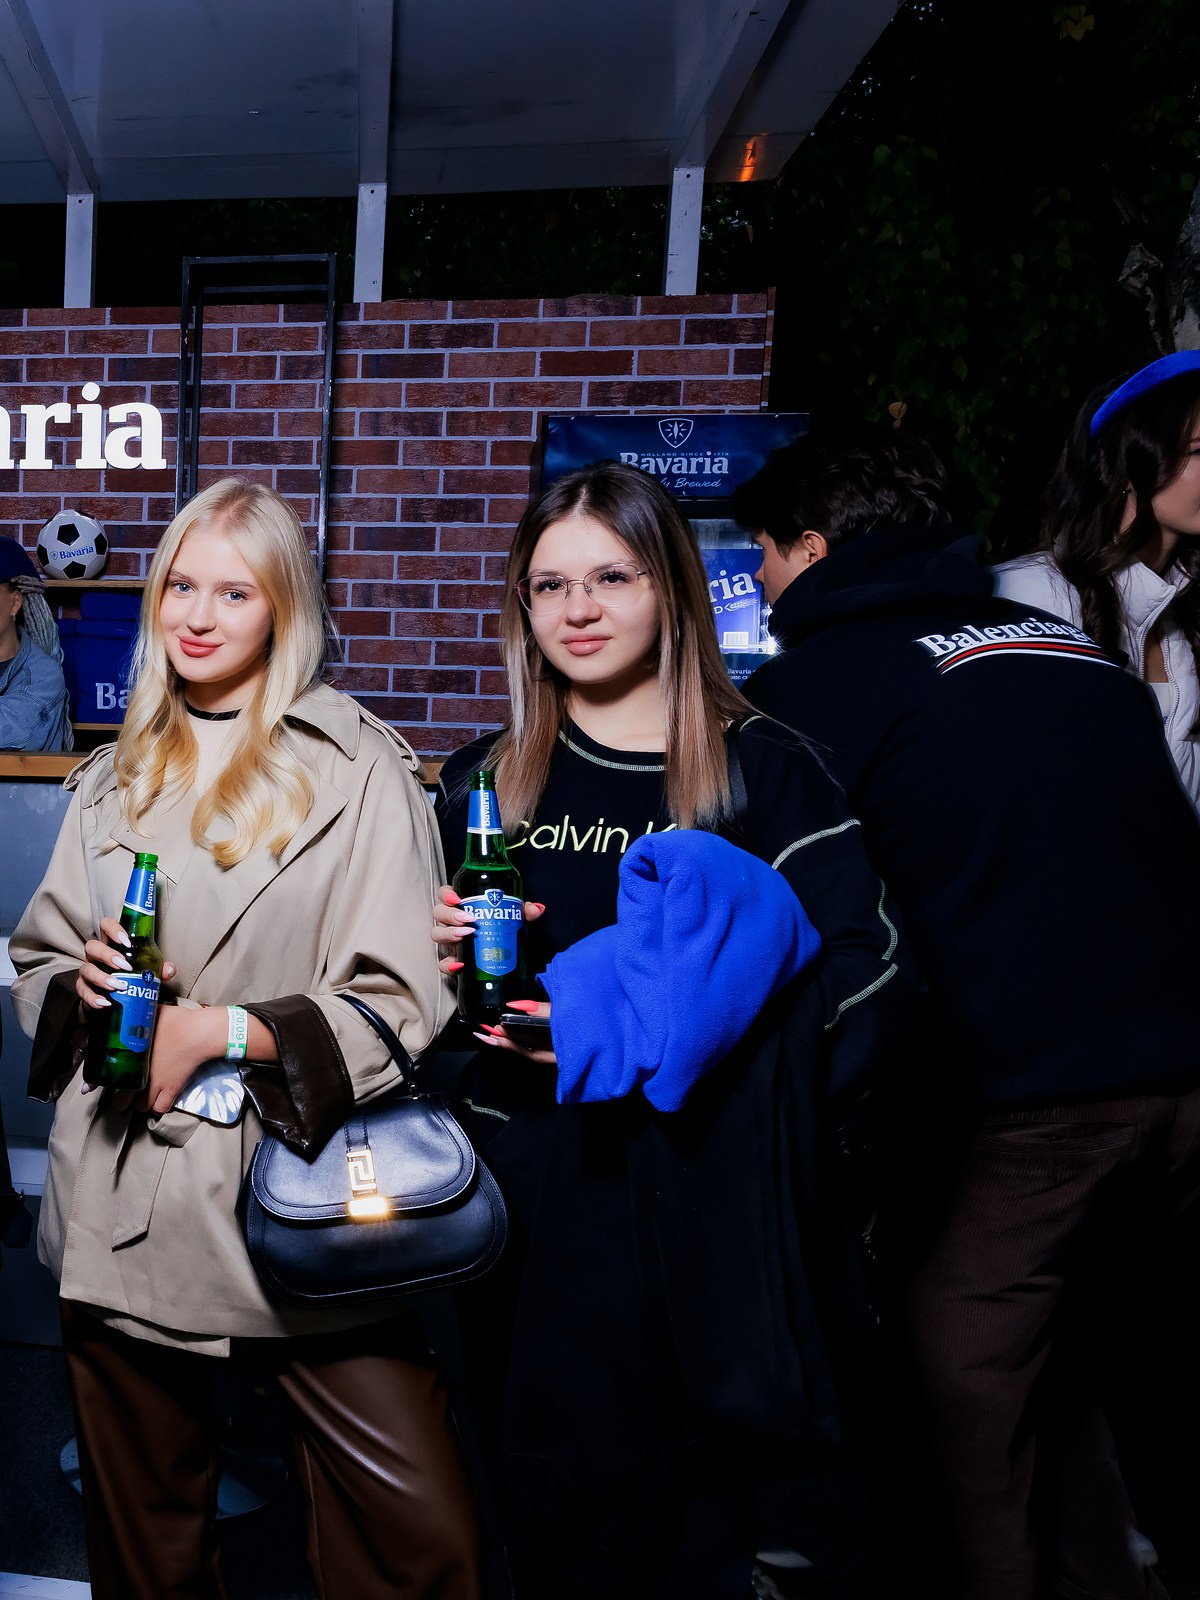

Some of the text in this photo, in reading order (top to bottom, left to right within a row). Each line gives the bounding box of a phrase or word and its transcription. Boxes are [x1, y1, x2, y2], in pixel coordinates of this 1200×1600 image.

[620, 451, 729, 474] Bavaria
[674, 478, 721, 488] Brewed
[59, 545, 94, 560] Bavaria
[145, 873, 155, 908] Bavaria
[236, 1011, 245, 1041] 20.09
